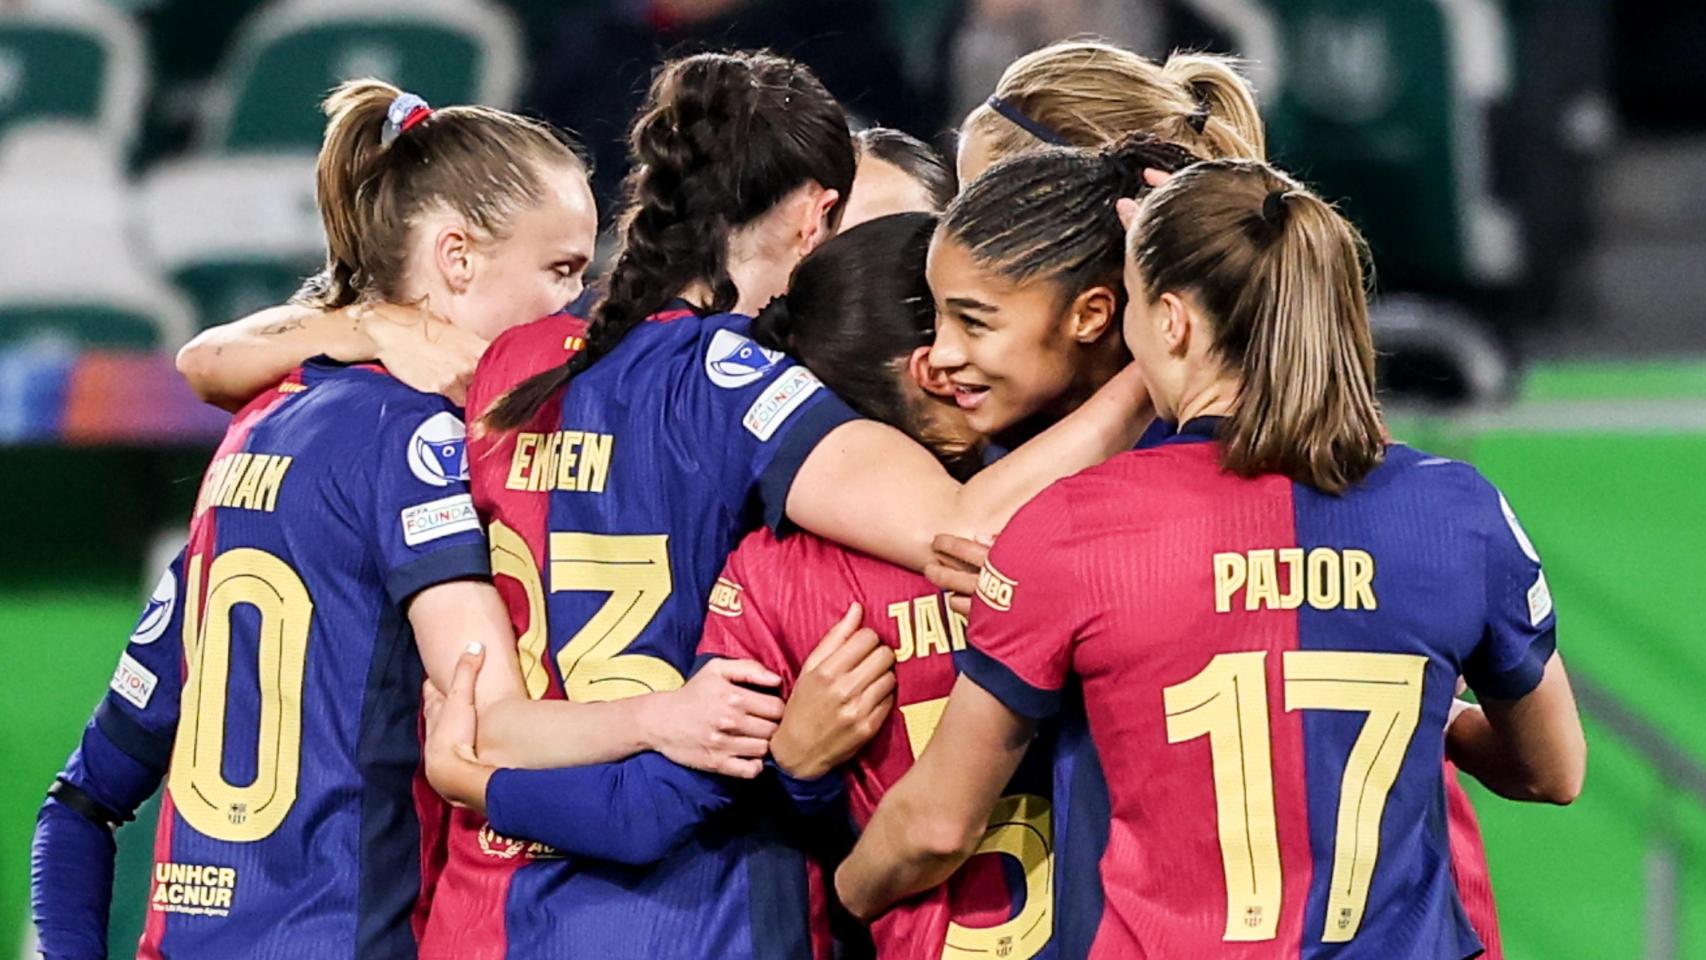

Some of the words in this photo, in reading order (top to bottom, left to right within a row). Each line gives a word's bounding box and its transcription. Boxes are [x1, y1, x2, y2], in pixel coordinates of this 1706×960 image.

[752, 373, 810, 431] FOUNDAT
[504, 429, 614, 494] ENGEN
[406, 504, 474, 532] FOUNDA
[709, 582, 741, 611] MBO
[976, 566, 1014, 607] MBO
[1212, 547, 1377, 613] PAJOR
[888, 591, 969, 663] JAN
[120, 666, 151, 697] TION
[1162, 650, 1430, 943] 17
[153, 884, 232, 907] ACNUR
[156, 863, 235, 887] UNHCR
